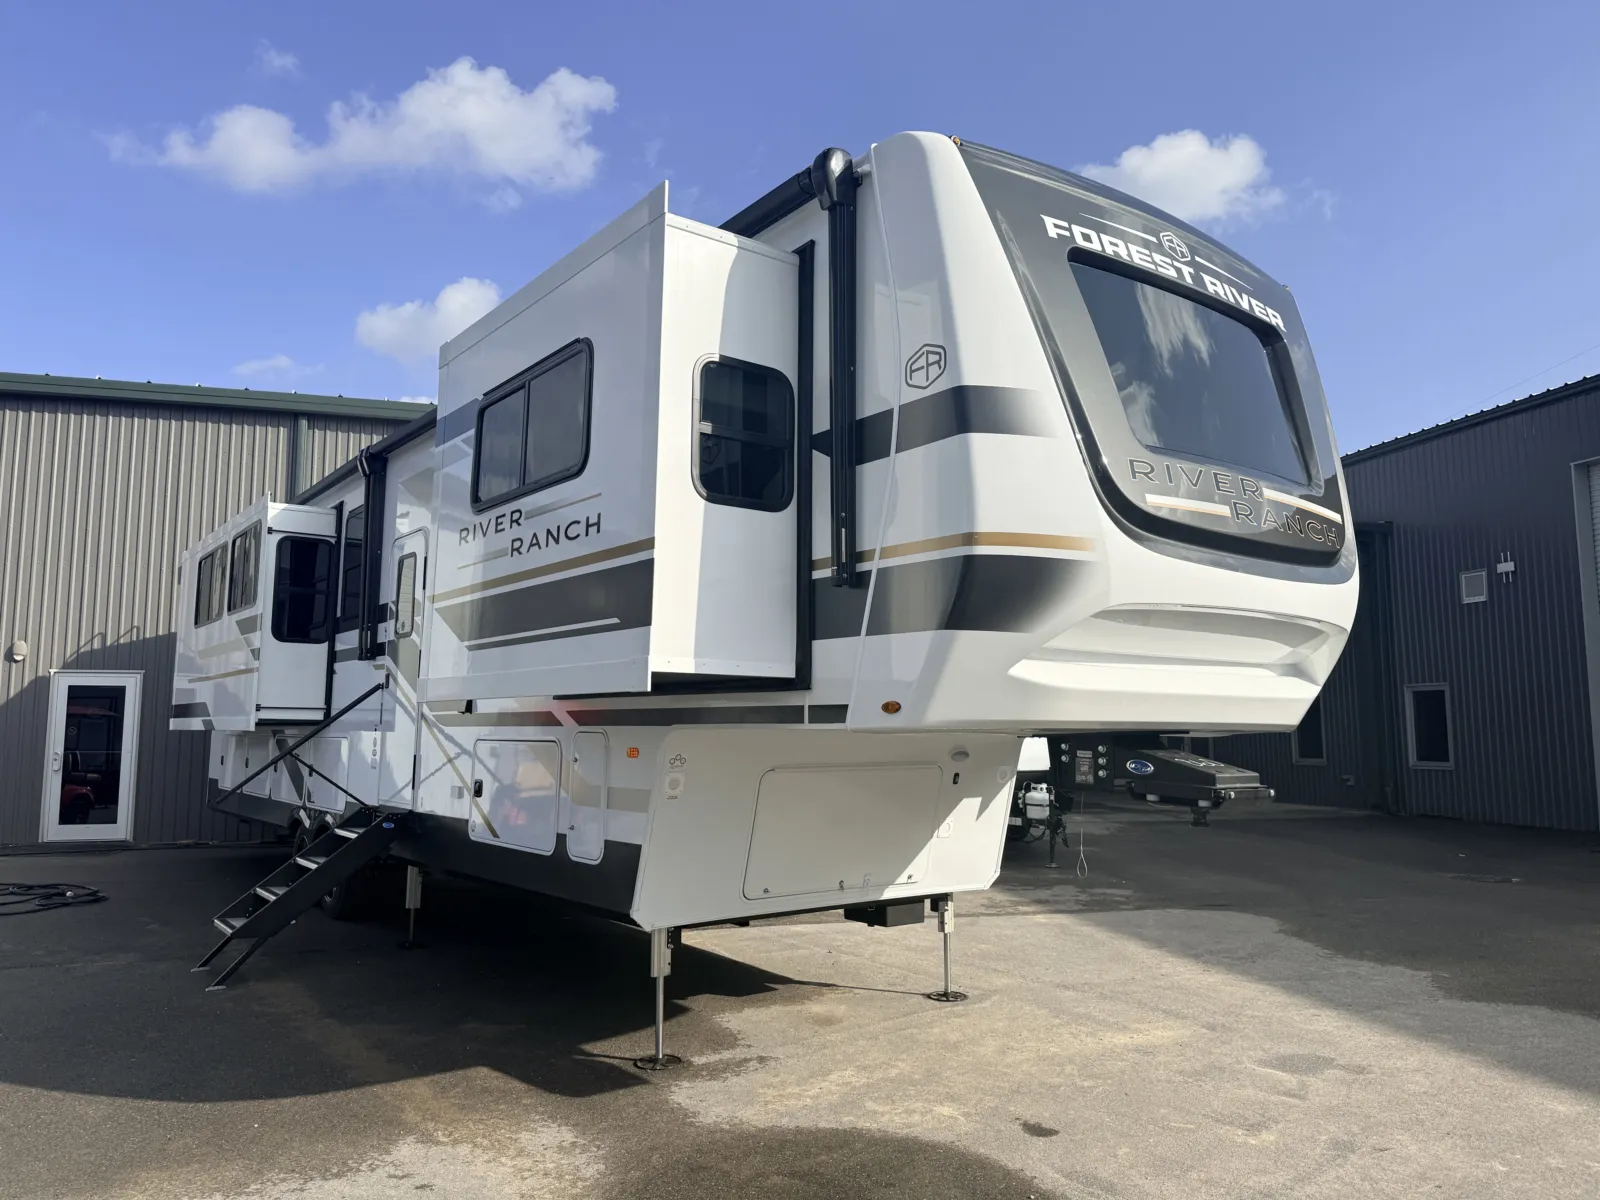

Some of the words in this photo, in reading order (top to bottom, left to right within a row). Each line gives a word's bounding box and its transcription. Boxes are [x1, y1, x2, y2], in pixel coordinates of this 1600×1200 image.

[1039, 213, 1195, 285] FOREST
[1199, 271, 1287, 333] RIVER
[1128, 457, 1264, 502] RIVER
[458, 508, 524, 547] RIVER
[510, 512, 602, 558] RANCH
[1230, 500, 1341, 549] RANCH
